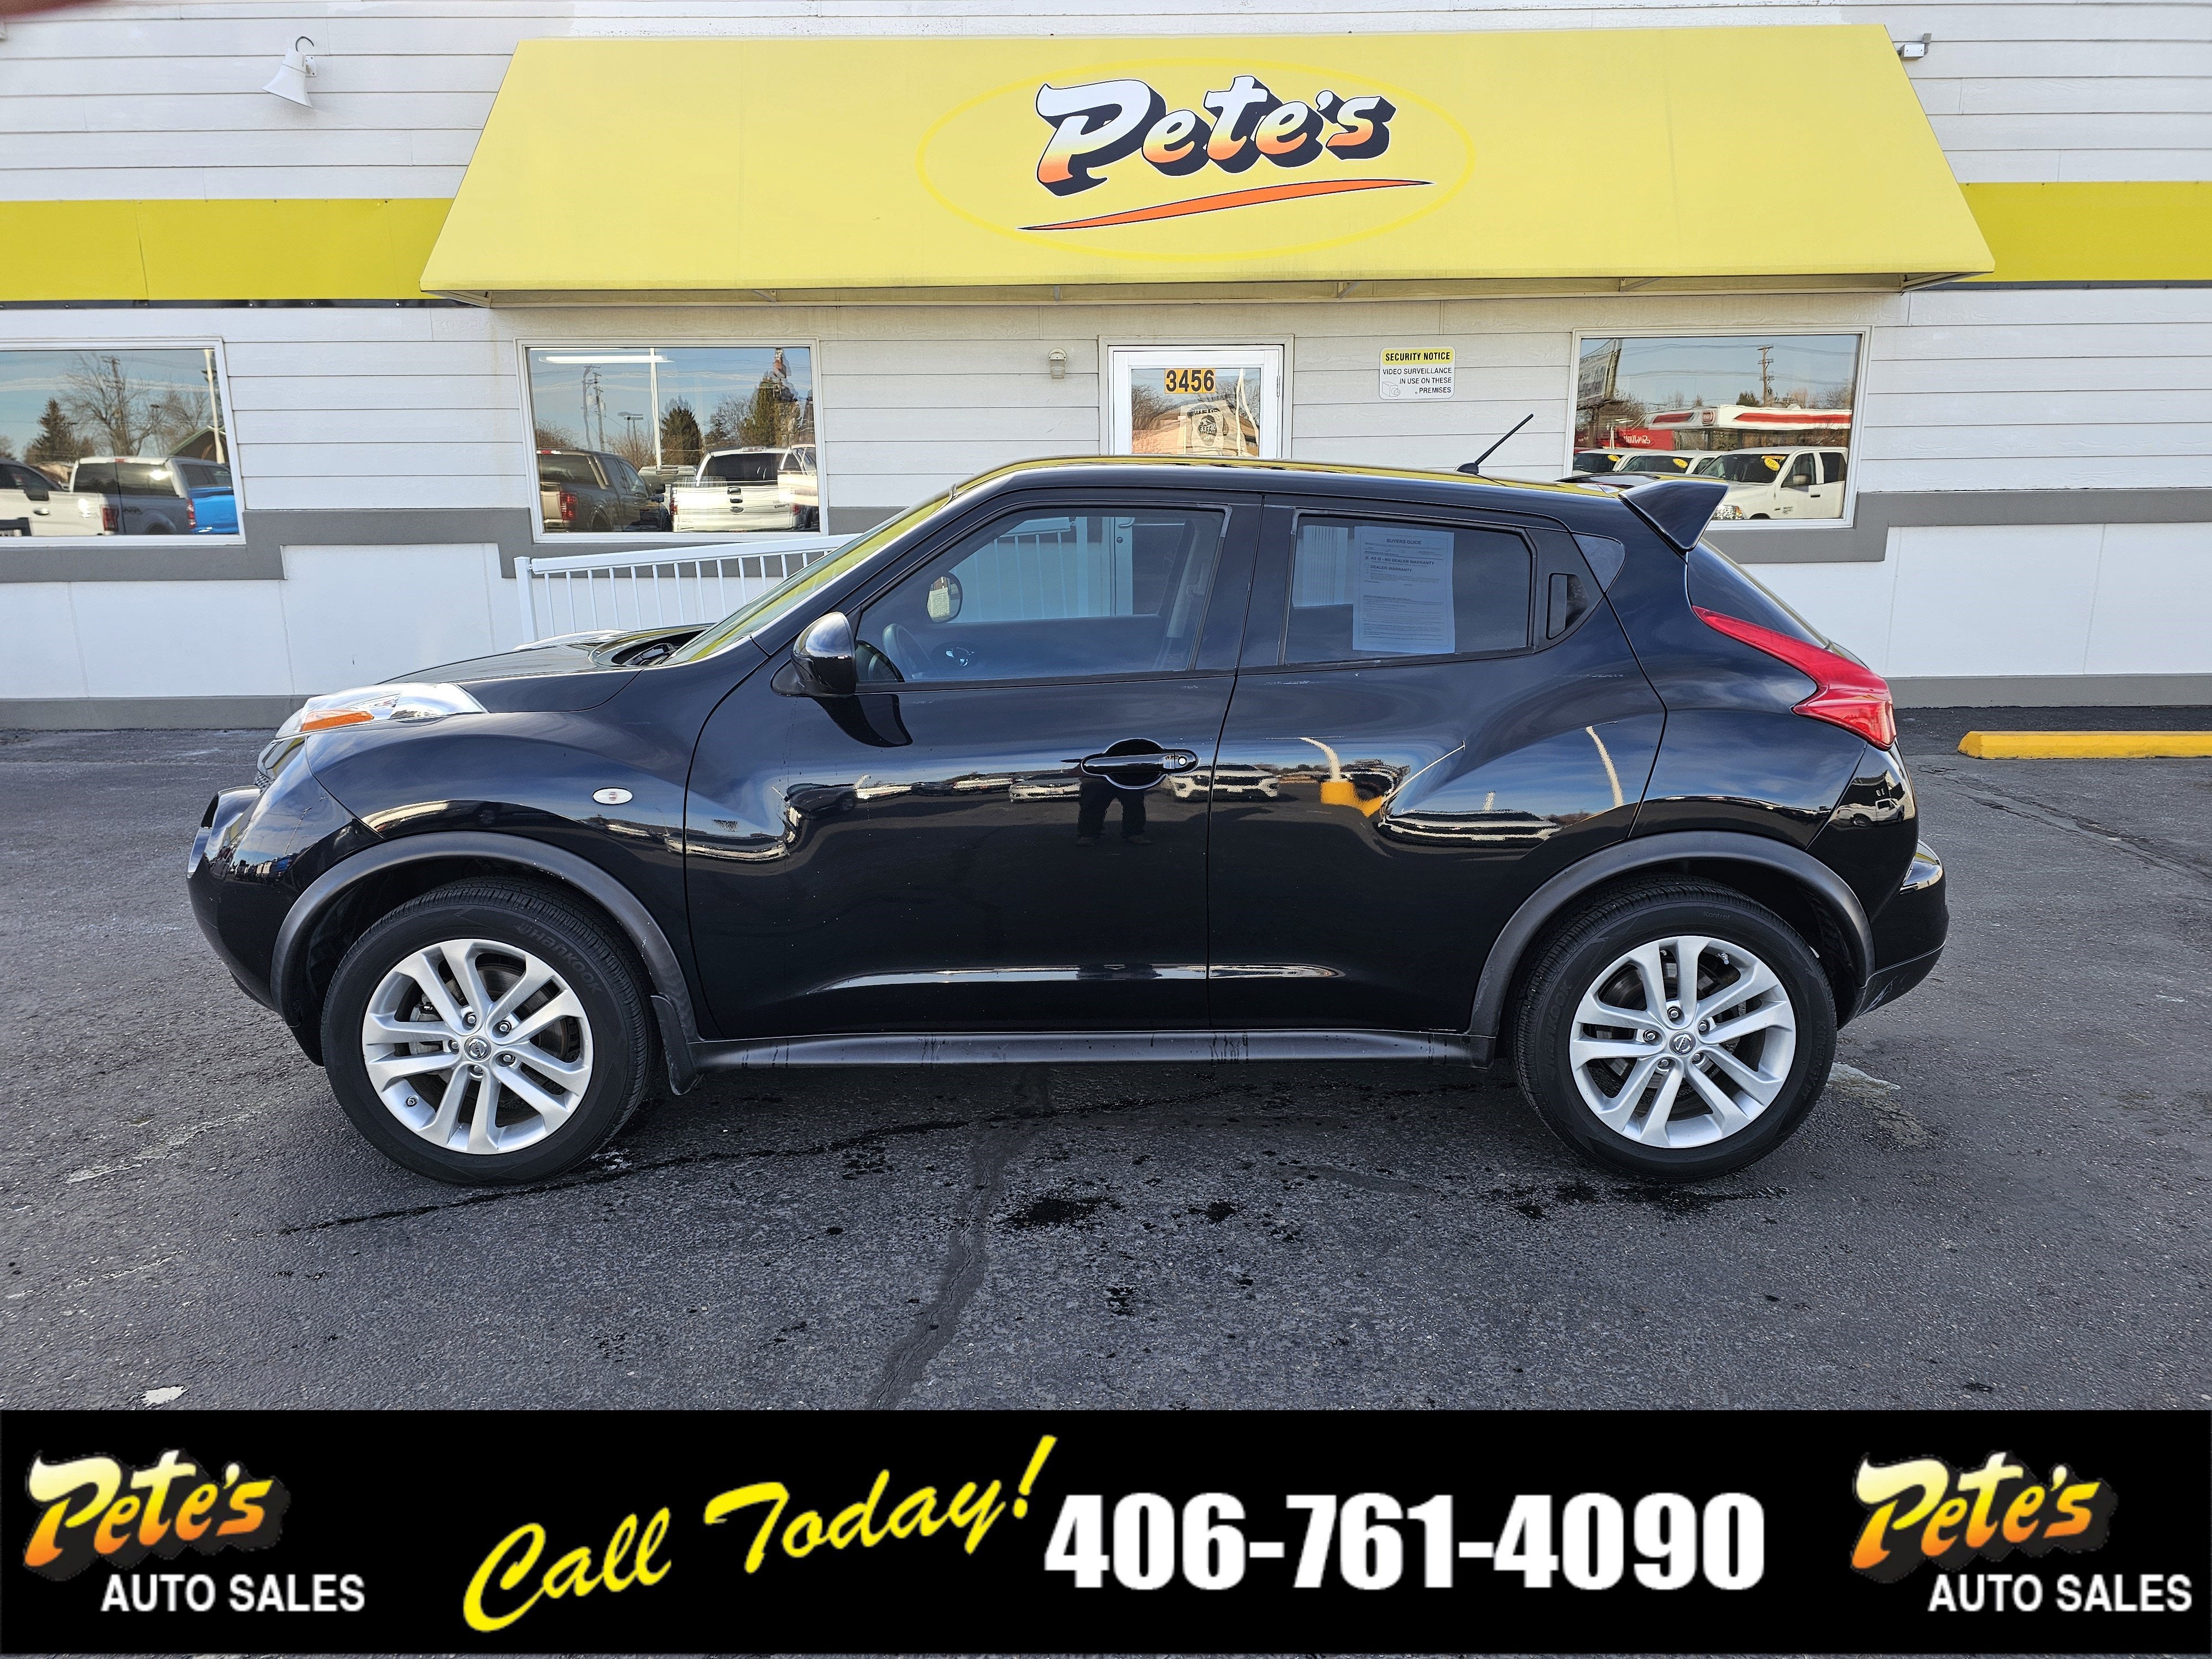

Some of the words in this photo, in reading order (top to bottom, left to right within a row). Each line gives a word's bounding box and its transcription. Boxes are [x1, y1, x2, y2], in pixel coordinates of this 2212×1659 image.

[1034, 75, 1396, 197] Pete's
[1385, 353, 1421, 361] SECURITY
[1423, 352, 1451, 360] NOTICE
[1166, 369, 1214, 392] 3456
